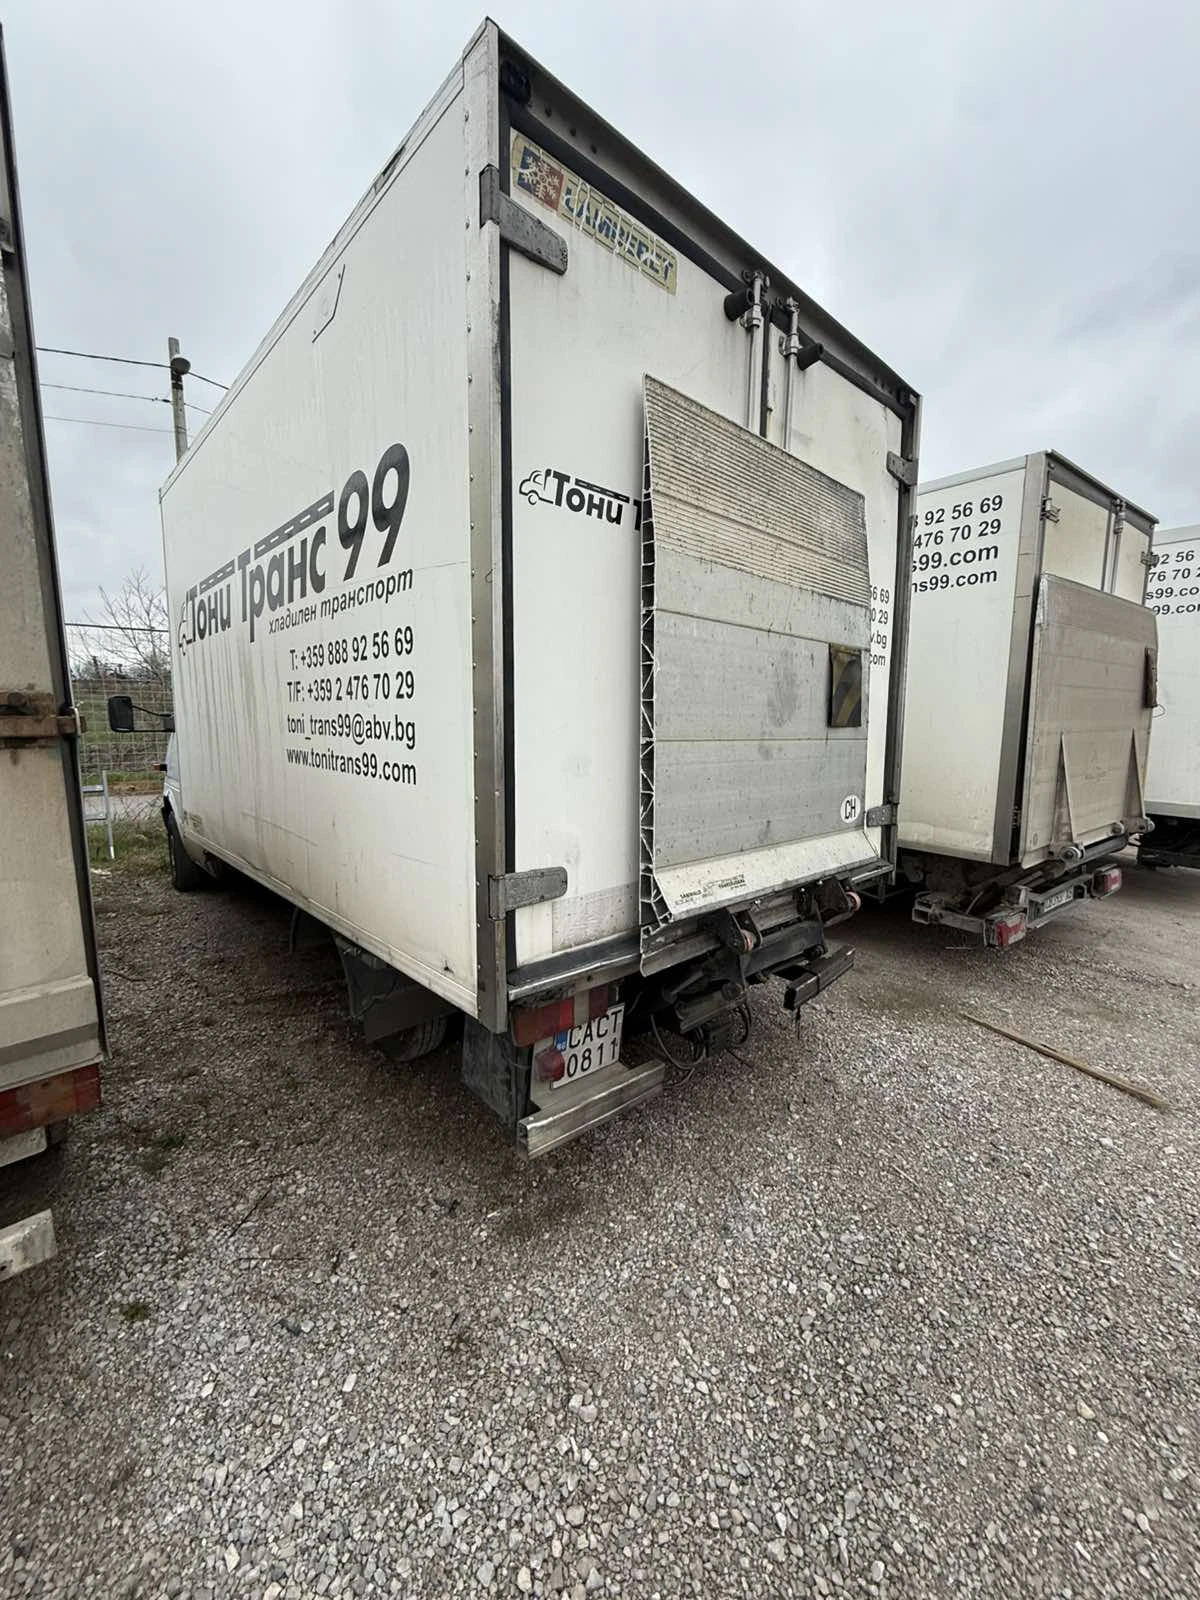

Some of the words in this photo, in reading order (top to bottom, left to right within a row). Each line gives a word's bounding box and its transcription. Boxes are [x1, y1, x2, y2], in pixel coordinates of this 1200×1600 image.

[552, 470, 623, 525] Тони
[925, 508, 945, 526] 92
[952, 502, 973, 520] 56
[980, 495, 1003, 513] 69
[186, 584, 231, 643] Тони
[238, 525, 327, 643] Транс
[338, 442, 410, 582] 99
[914, 530, 944, 549] 476
[951, 524, 971, 542] 70
[978, 518, 1002, 537] 29
[1159, 553, 1170, 565] 2
[1175, 550, 1194, 563] 56
[1172, 568, 1191, 580] 70
[269, 602, 316, 635] хладилен
[321, 569, 413, 619] транспорт
[879, 588, 890, 604] 69
[1152, 604, 1200, 615] 99.co
[878, 609, 889, 625] 29
[289, 648, 299, 670] T:
[301, 643, 325, 668] +359
[327, 638, 348, 665] 888
[352, 634, 368, 662] 92
[373, 630, 389, 659] 56
[395, 625, 413, 656] 69
[287, 680, 305, 703] T/F:
[307, 678, 332, 702] +359
[335, 676, 342, 701] 2
[346, 674, 369, 700] 476
[373, 672, 390, 700] 70
[395, 670, 414, 699] 29
[287, 713, 416, 750] toni_trans99@abv.bg
[286, 747, 417, 785] www.tonitrans99.com
[844, 798, 857, 820] CH
[567, 1009, 622, 1049] CACT
[566, 1037, 618, 1078] 0811
